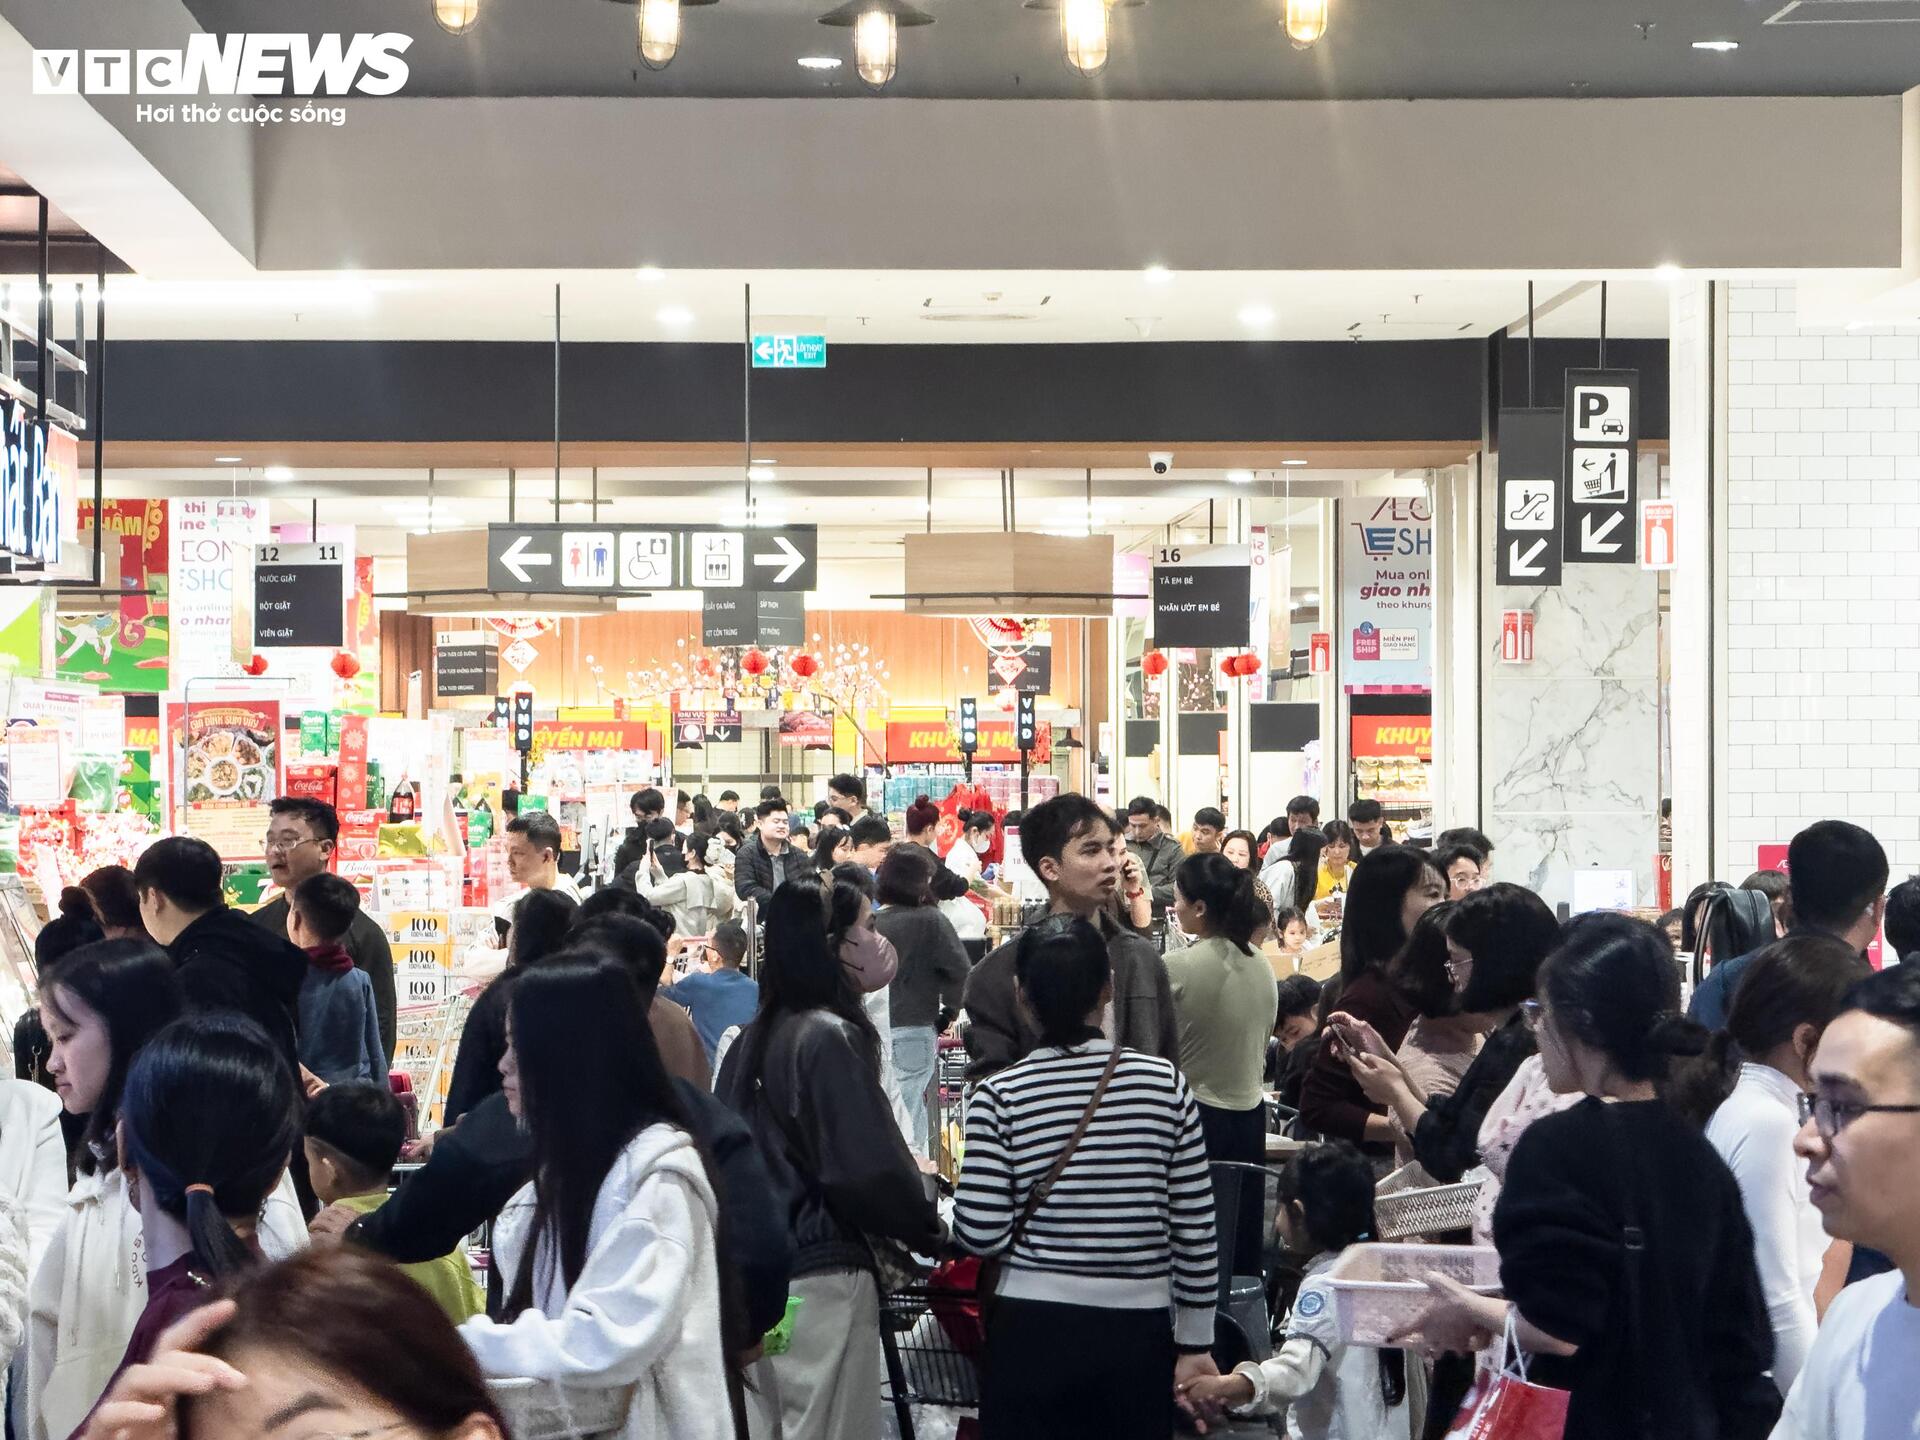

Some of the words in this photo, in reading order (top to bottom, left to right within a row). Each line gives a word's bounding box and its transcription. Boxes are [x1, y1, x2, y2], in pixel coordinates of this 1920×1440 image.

[803, 352, 817, 360] EXIT
[1579, 392, 1609, 429] P
[184, 501, 206, 516] thị
[260, 547, 280, 562] 12
[318, 546, 338, 560] 11
[1160, 549, 1181, 563] 16
[259, 574, 279, 583] NƯỚC
[1171, 577, 1182, 585] EM
[1183, 575, 1194, 585] BÉ
[1376, 570, 1404, 580] Mua
[1360, 582, 1402, 600] giao
[1159, 602, 1179, 612] KHĂN
[1198, 603, 1209, 612] EM
[1376, 600, 1399, 609] theo
[259, 628, 275, 638] VIÊN
[441, 635, 451, 644] 11
[1356, 639, 1377, 647] FREE
[1356, 646, 1377, 654] SHIP
[411, 918, 438, 932] 100
[409, 950, 435, 963] 100
[409, 981, 436, 995] 100
